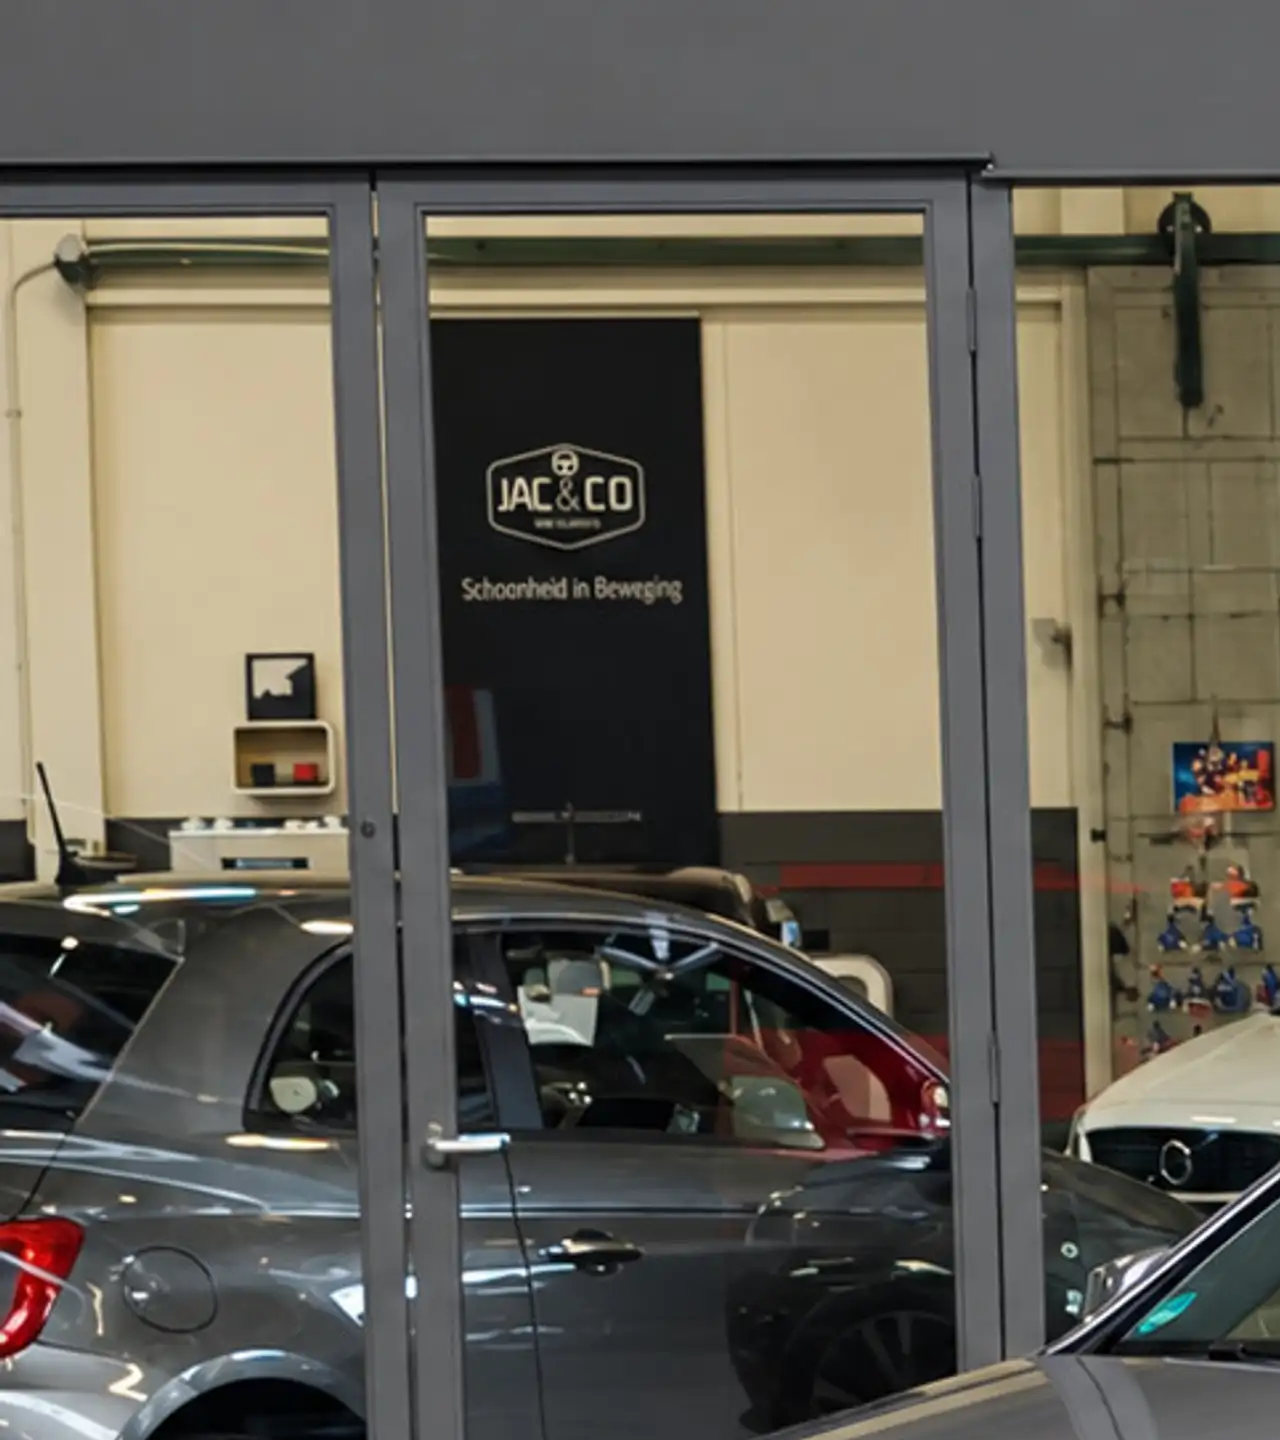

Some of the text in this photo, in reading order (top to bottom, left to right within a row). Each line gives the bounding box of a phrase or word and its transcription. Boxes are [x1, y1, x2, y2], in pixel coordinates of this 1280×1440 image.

[461, 575, 683, 605] Schoonheid in Beweging
